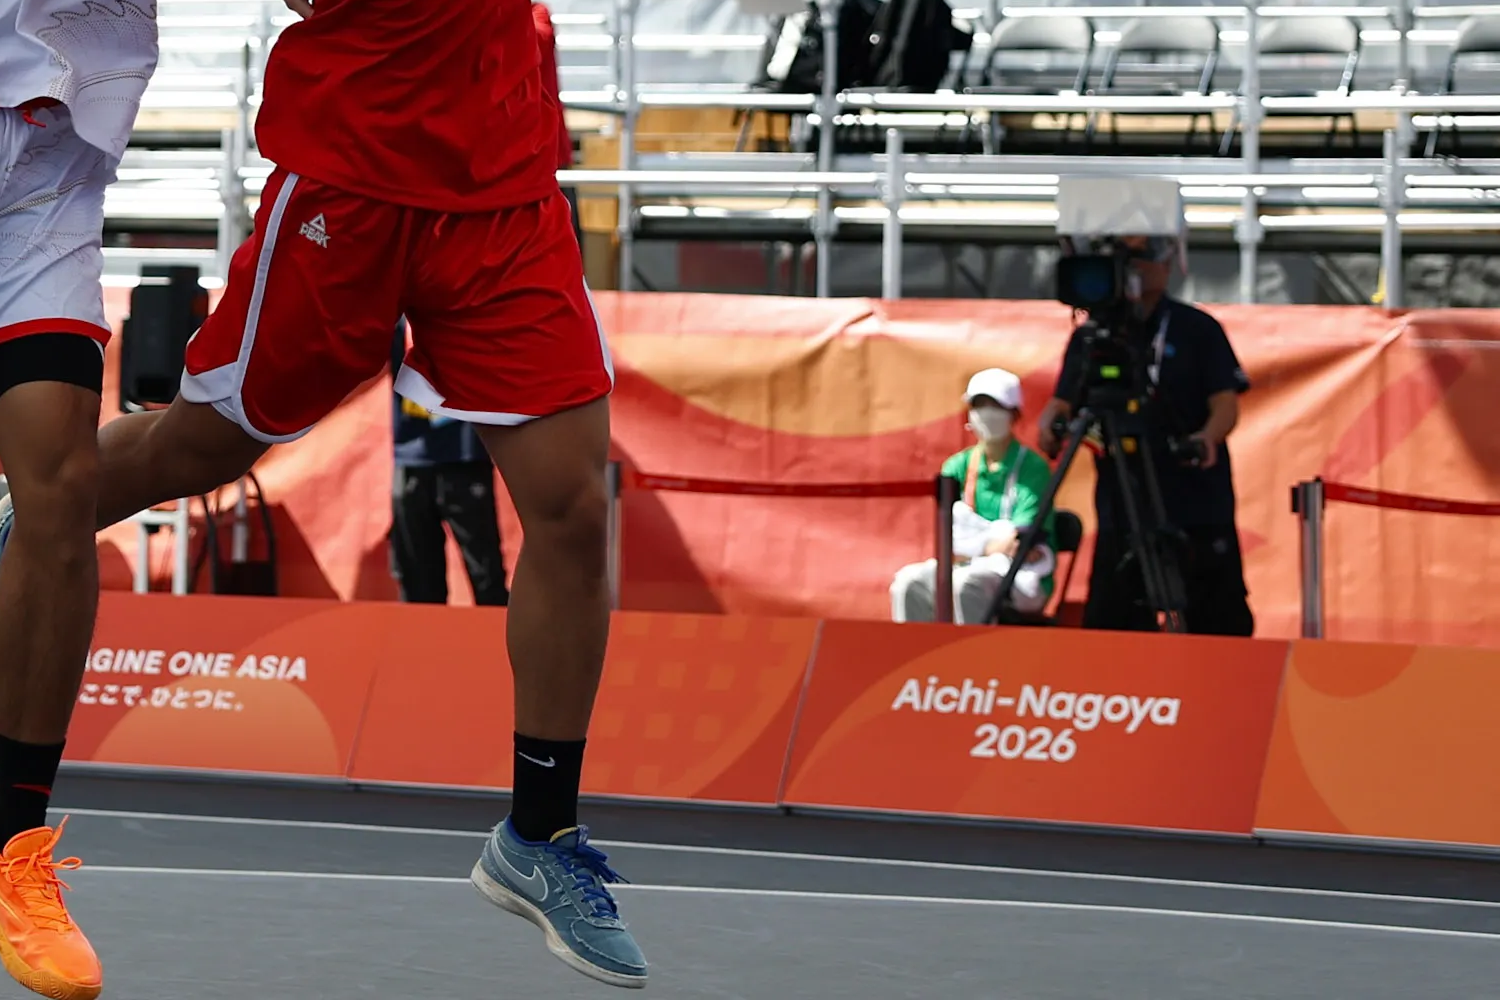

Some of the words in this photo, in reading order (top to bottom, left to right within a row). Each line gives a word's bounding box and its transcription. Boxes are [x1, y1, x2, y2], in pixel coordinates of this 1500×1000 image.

[298, 221, 332, 249] PEAK
[168, 651, 235, 677] ONE
[235, 654, 308, 681] ASIA
[891, 675, 1181, 734] Aichi-Nagoya
[969, 723, 1078, 763] 2026
